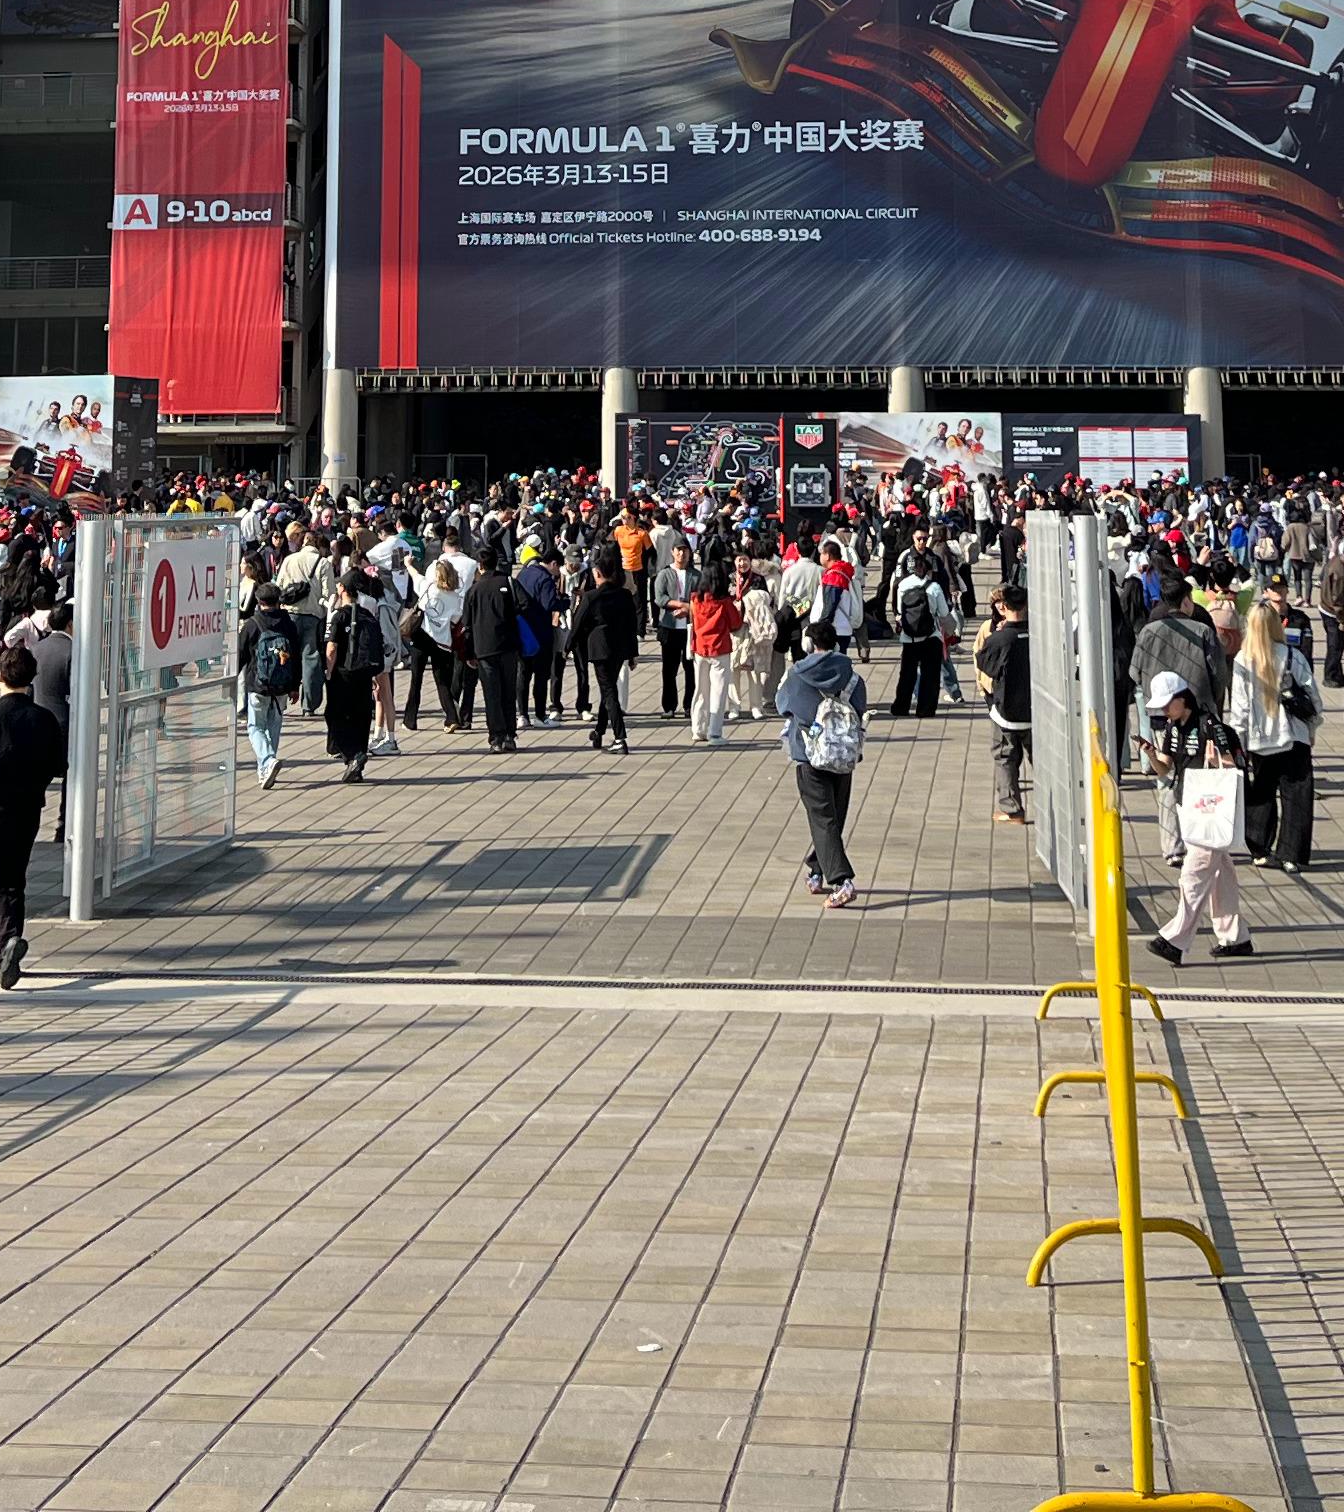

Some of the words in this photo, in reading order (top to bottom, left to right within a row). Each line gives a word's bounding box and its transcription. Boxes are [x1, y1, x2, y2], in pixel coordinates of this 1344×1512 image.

[131, 0, 280, 80] Shanghai
[126, 90, 189, 102] FORMULA
[459, 126, 648, 155] FORMULA
[458, 163, 669, 186] 2026年3月13-15日
[123, 198, 153, 225] A
[457, 210, 537, 225] 上海国际赛车场
[677, 208, 750, 222] SHANGHAI
[752, 207, 863, 221] INTERNATIONAL
[865, 207, 920, 220] CIRCUIT
[549, 232, 594, 244] Official
[597, 231, 644, 244] Tickets
[646, 231, 697, 244] Hotline:
[698, 228, 822, 243] 400-688-9194
[797, 425, 822, 434] TAG
[187, 564, 216, 602] 入口
[158, 575, 168, 633] 1
[177, 611, 222, 639] ENTRANCE
